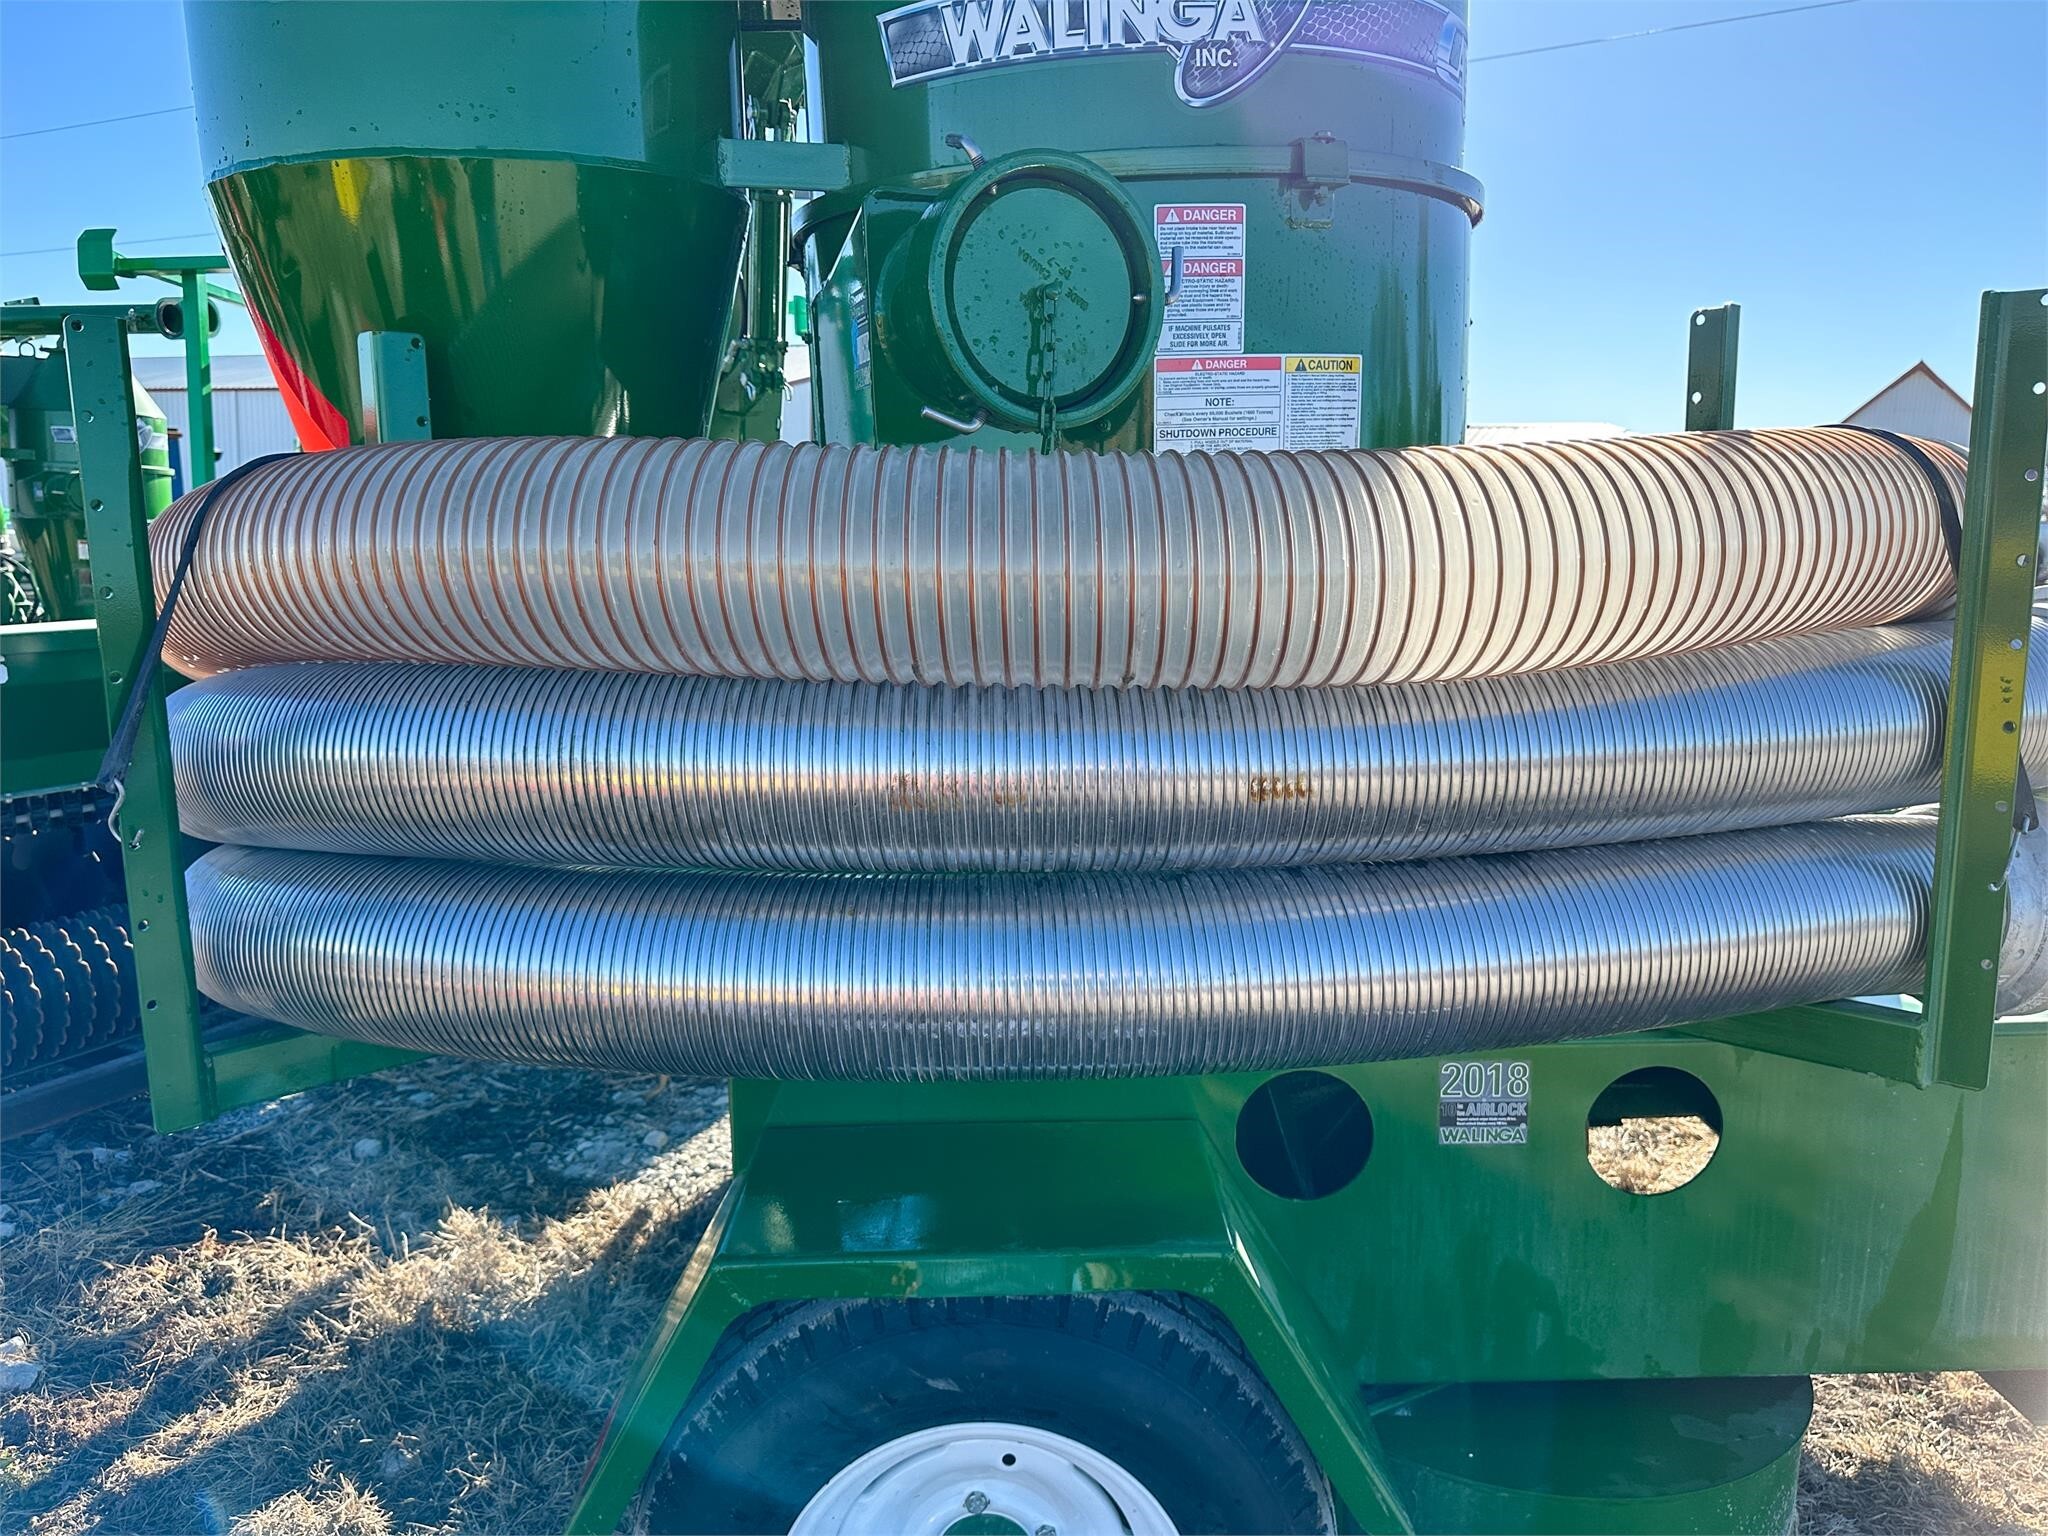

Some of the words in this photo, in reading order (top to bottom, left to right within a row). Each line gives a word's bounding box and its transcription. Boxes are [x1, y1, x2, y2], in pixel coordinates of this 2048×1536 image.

[939, 0, 1267, 66] WALINGA
[1195, 49, 1238, 67] INC.
[1184, 210, 1236, 220] DANGER
[1184, 262, 1236, 273] DANGER
[1206, 360, 1247, 369] DANGER
[1308, 360, 1352, 370] CAUTION
[1205, 398, 1235, 406] NOTE:
[1160, 429, 1216, 438] SHUTDOWN
[1218, 427, 1277, 436] PROCEDURE
[1440, 1062, 1529, 1097] 2018
[1465, 1102, 1527, 1116] AIRLOCK
[1440, 1127, 1526, 1143] WALINGA
